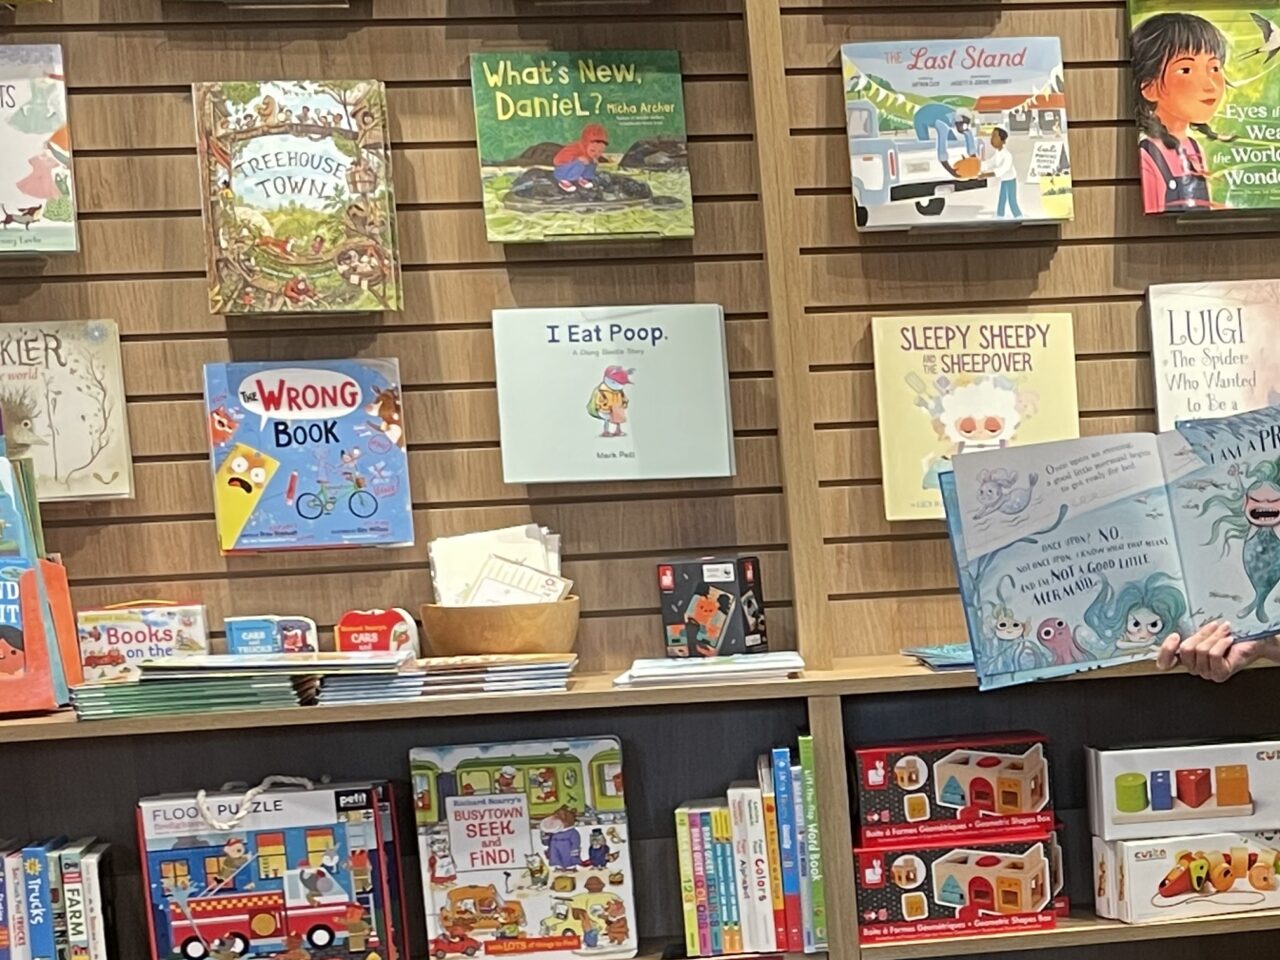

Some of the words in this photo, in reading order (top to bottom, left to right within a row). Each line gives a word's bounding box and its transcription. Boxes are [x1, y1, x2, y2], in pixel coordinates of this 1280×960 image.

[884, 51, 903, 65] THE
[906, 47, 954, 71] Last
[961, 45, 1028, 70] Stand
[482, 60, 569, 88] What's
[577, 58, 642, 85] New,
[606, 102, 637, 115] Micha
[640, 102, 675, 115] Archer
[1225, 103, 1268, 122] Eyes
[234, 150, 348, 180] TREEHOUSE
[1213, 149, 1231, 165] the
[254, 175, 329, 201] TOWN
[546, 325, 561, 344] I
[567, 324, 603, 343] Eat
[609, 323, 669, 347] Poop.
[900, 325, 971, 351] SLEEPY
[978, 324, 1051, 350] SHEEPY
[1167, 307, 1246, 346] LUIGI
[922, 354, 937, 364] AND
[941, 352, 1033, 374] SHEEPOVER
[923, 364, 938, 375] THE
[1170, 349, 1196, 368] The
[1201, 347, 1249, 371] Spider
[8, 367, 38, 380] world
[1166, 372, 1199, 391] Who
[1203, 370, 1257, 390] Wanted
[239, 390, 259, 404] THE
[256, 379, 359, 412] WRONG
[1187, 398, 1201, 413] to
[1206, 393, 1227, 412] Be
[1231, 402, 1239, 411] a
[273, 420, 341, 448] BOOK
[1210, 452, 1216, 465] I
[1219, 446, 1243, 461] AM
[1247, 439, 1256, 452] A
[1050, 565, 1075, 583] NOT
[1078, 565, 1085, 575] A
[1087, 559, 1116, 574] GOOD
[1119, 553, 1150, 570] LITTLE
[107, 625, 173, 646] Books
[240, 630, 265, 641] CARS
[350, 632, 378, 643] CARS
[126, 647, 146, 659] on
[150, 645, 172, 658] the
[339, 792, 367, 808] petit
[466, 820, 516, 839] SEEK
[975, 818, 1010, 829] Geometric
[1011, 816, 1036, 827] Shapes
[1037, 814, 1051, 823] Box
[481, 837, 502, 848] and
[806, 822, 821, 852] Word
[809, 853, 823, 882] Book
[754, 858, 770, 902] Colors
[27, 878, 47, 925] Trucks
[66, 888, 85, 936] FARM
[16, 916, 26, 946] TRUCKS
[974, 917, 1009, 928] Geometric
[1011, 914, 1037, 925] Shapes
[1038, 913, 1052, 922] Box
[503, 941, 527, 950] LOTS
